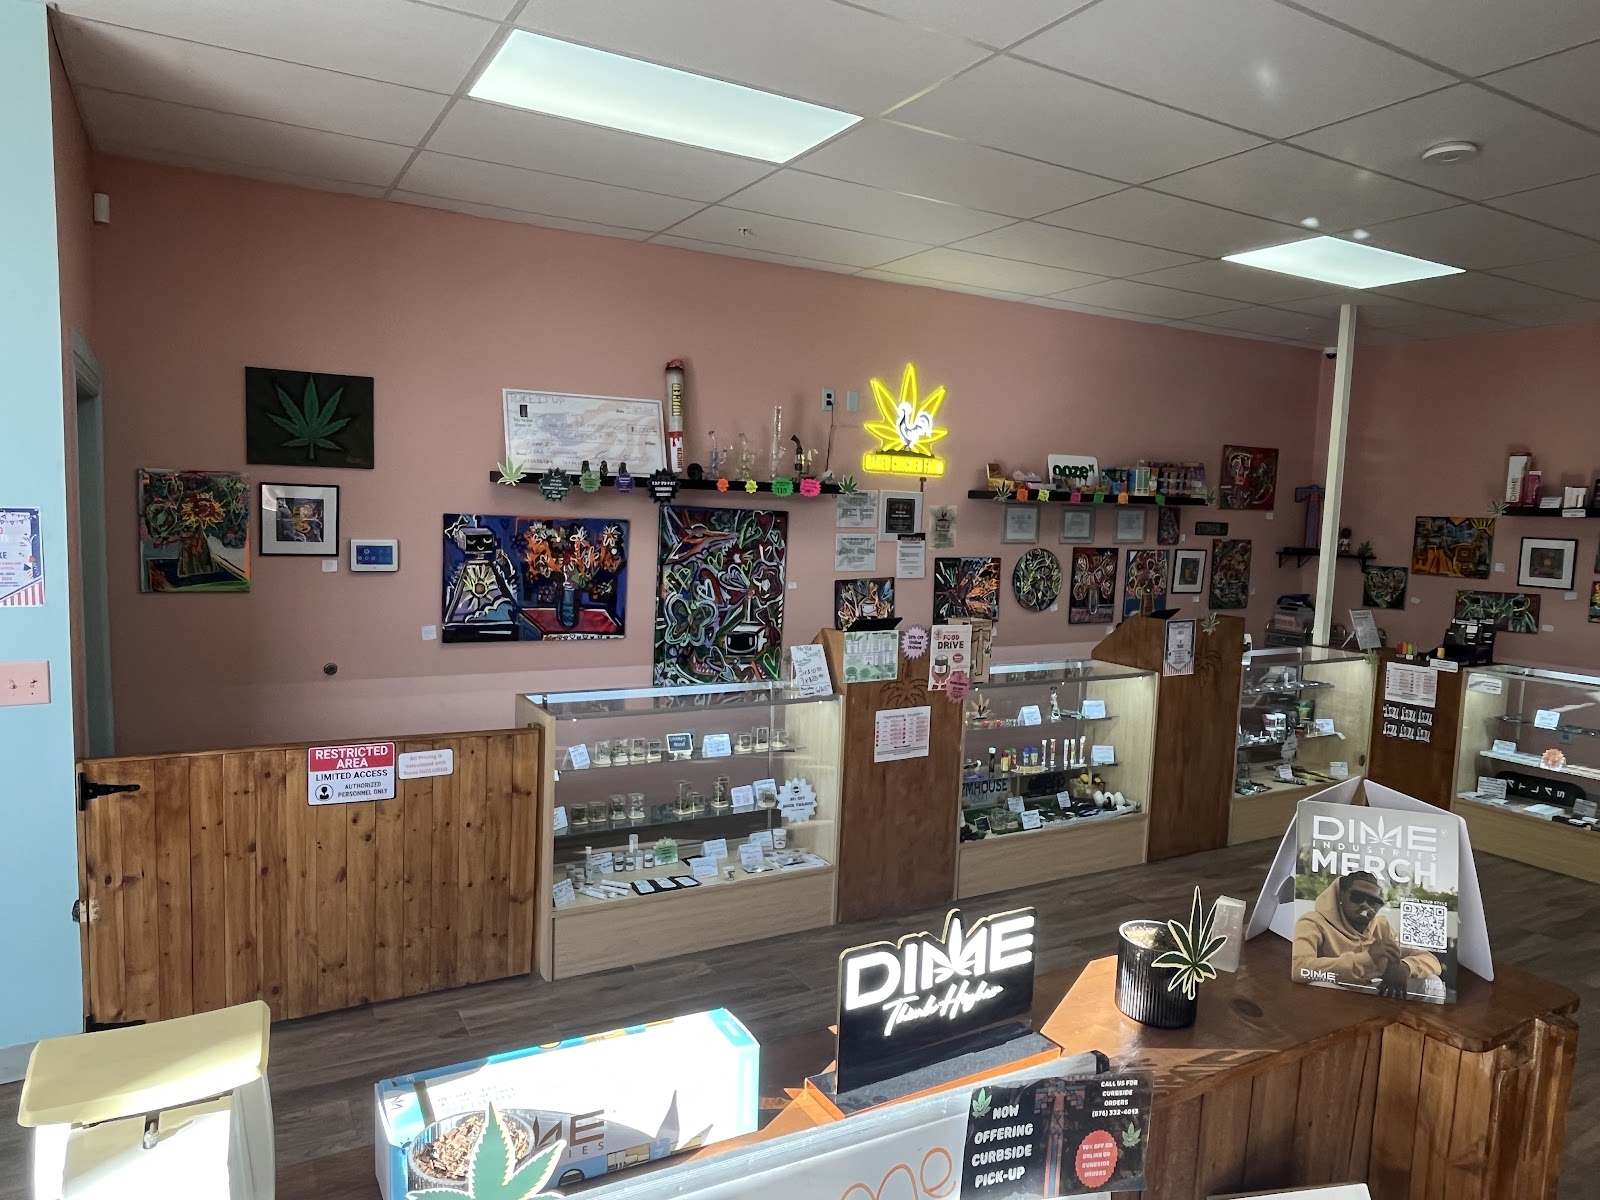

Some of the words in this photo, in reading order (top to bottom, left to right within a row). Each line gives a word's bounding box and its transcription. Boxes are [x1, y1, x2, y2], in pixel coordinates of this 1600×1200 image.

[937, 641, 965, 650] DRIVE
[315, 745, 388, 760] RESTRICTED
[336, 757, 369, 769] AREA
[315, 772, 351, 782] LIMITED
[353, 769, 388, 779] ACCESS
[344, 781, 382, 790] AUTHORIZED
[337, 789, 372, 798] PERSONNEL
[1313, 815, 1437, 852] DIME
[1312, 840, 1437, 861] INDUSTRIES
[1311, 849, 1437, 886] MERCH
[845, 916, 1035, 1010] DIME
[1300, 968, 1336, 982] DIME
[1101, 1080, 1116, 1088] CALL
[1102, 1089, 1133, 1097] CURBSIDE
[992, 1104, 1020, 1120] NOW
[974, 1123, 1034, 1145] OFFERING
[971, 1144, 1033, 1167] CURBSIDE
[974, 1166, 1026, 1188] PICK-UP
